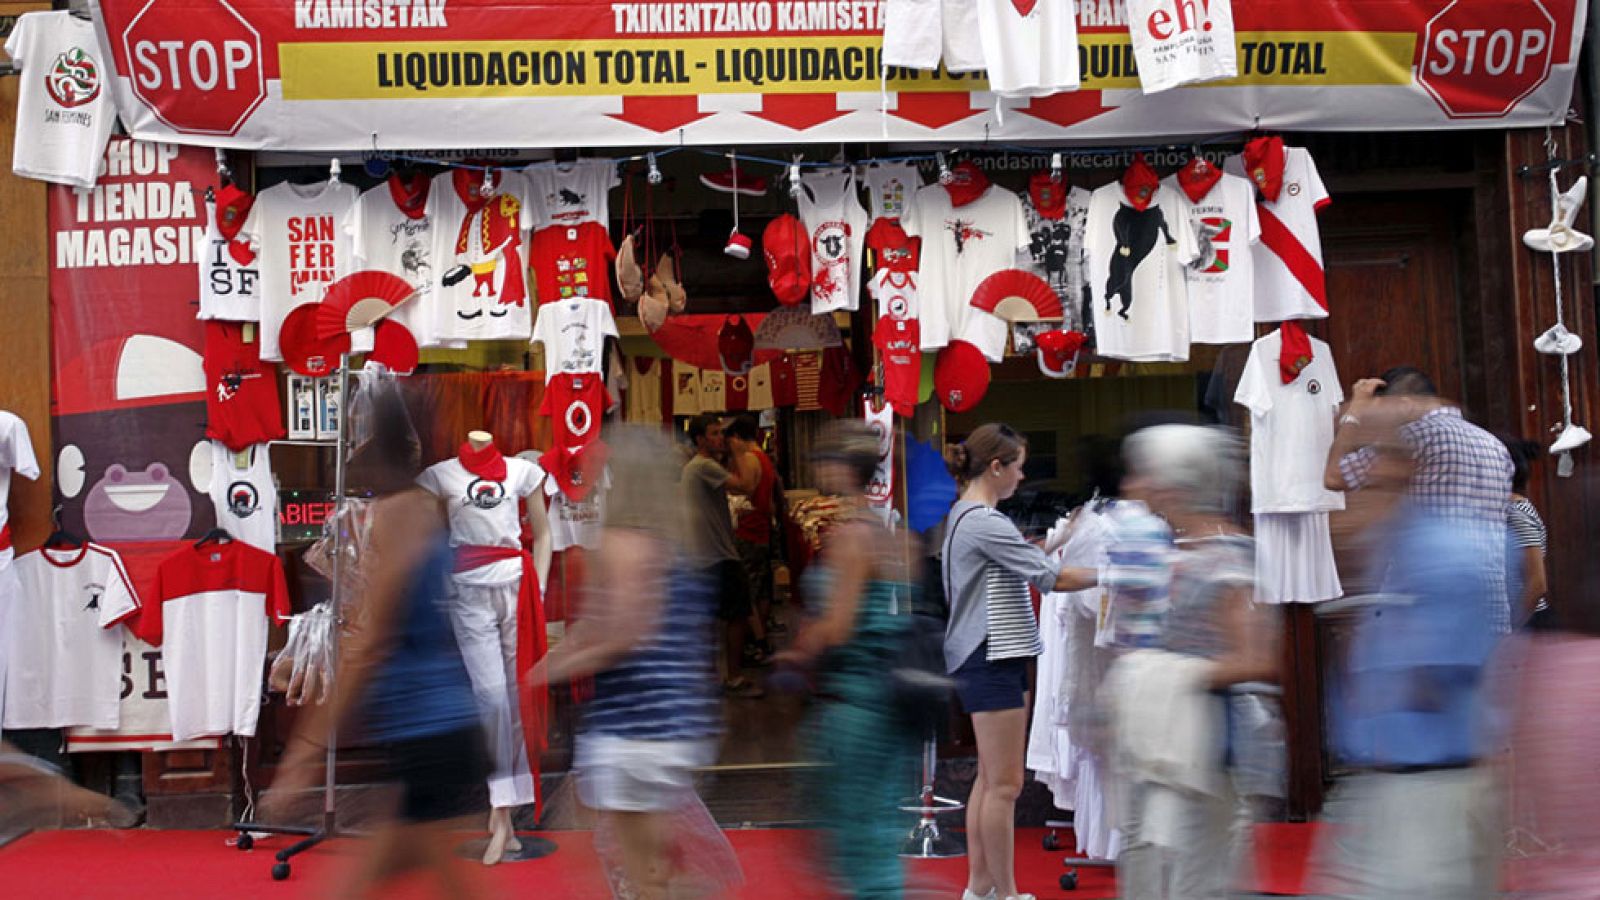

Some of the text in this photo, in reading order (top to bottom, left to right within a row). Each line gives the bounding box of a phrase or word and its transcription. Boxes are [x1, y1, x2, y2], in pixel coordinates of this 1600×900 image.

[294, 0, 447, 28] KAMISETAK
[611, 0, 885, 33] TXIKIENTZAKO KAMISETA
[1147, 0, 1212, 41] eh!
[134, 40, 252, 90] STOP
[377, 50, 586, 90] LIQUIDACION
[594, 49, 690, 84] TOTAL
[715, 46, 919, 84] LIQUIDACI
[1241, 41, 1327, 76] TOTAL
[1429, 28, 1546, 76] STOP
[72, 181, 197, 223] TIENDA
[288, 216, 335, 243] SAN
[289, 245, 336, 270] FER
[210, 269, 260, 295] SF
